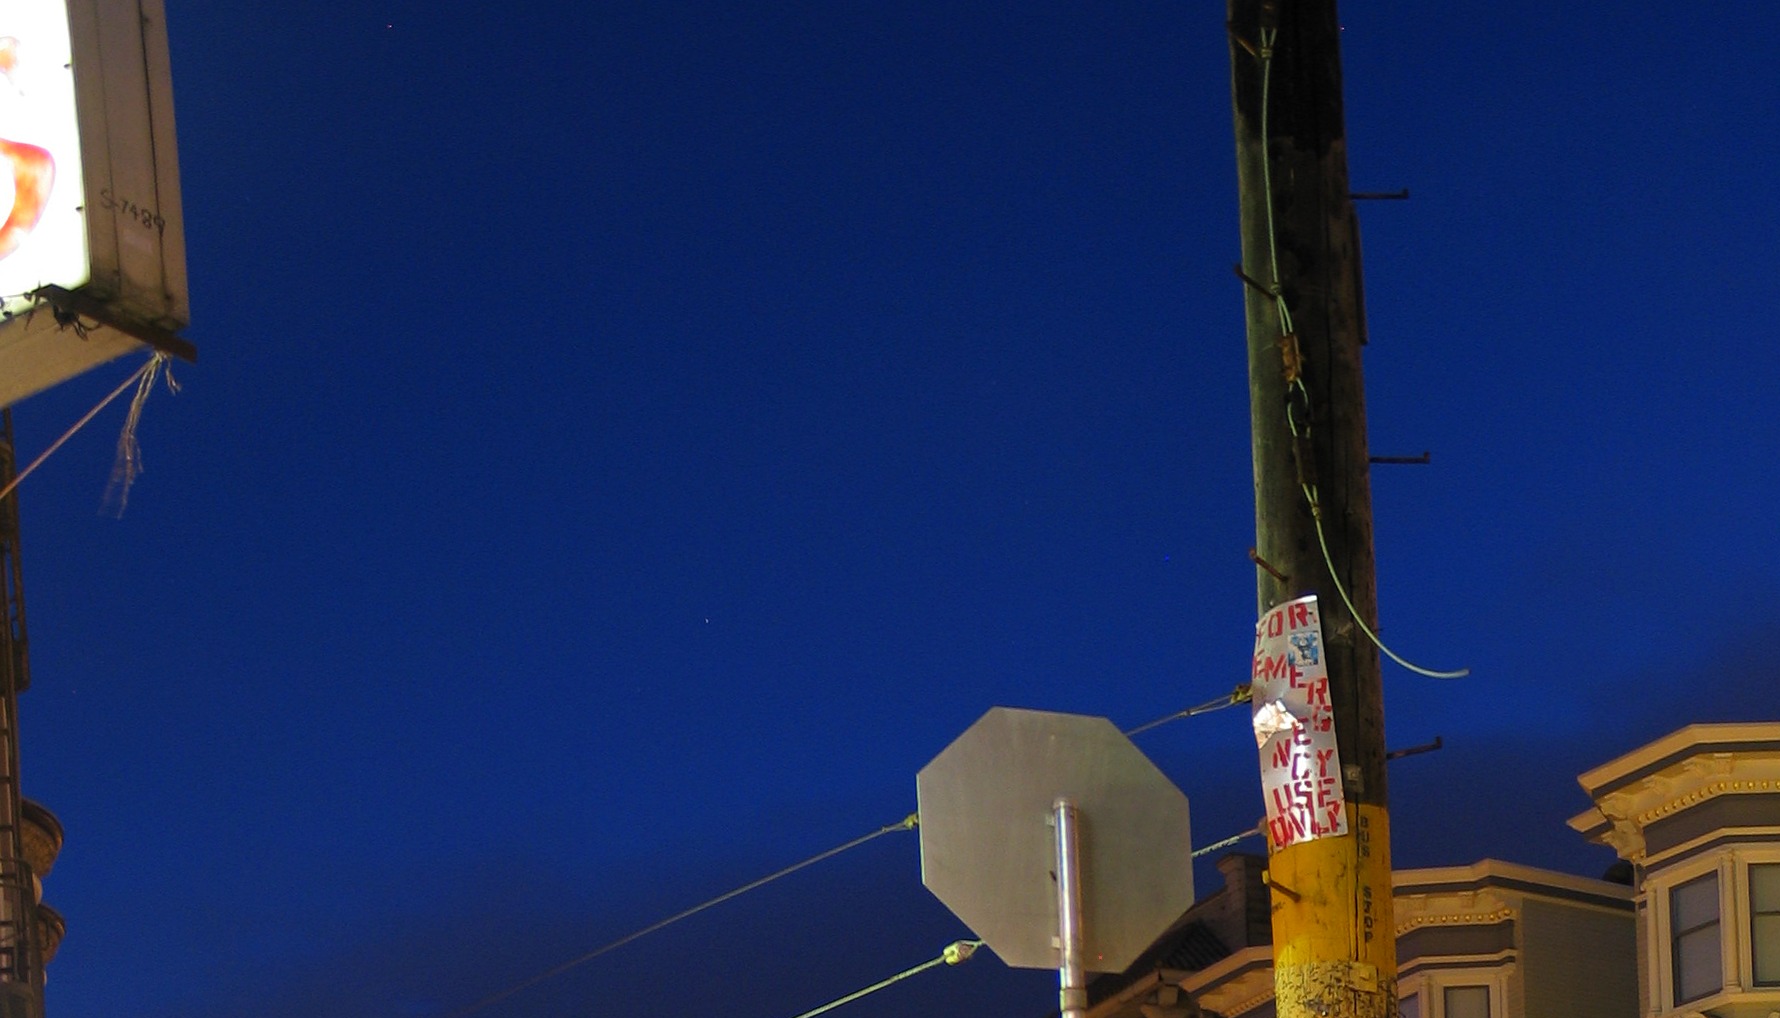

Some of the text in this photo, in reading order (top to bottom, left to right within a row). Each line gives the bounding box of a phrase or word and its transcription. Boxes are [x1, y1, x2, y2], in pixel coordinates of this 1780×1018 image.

[1256, 602, 1310, 647] FOR
[1272, 778, 1335, 812] USE
[1269, 800, 1341, 849] ONLY
[1363, 885, 1374, 943] STOP
